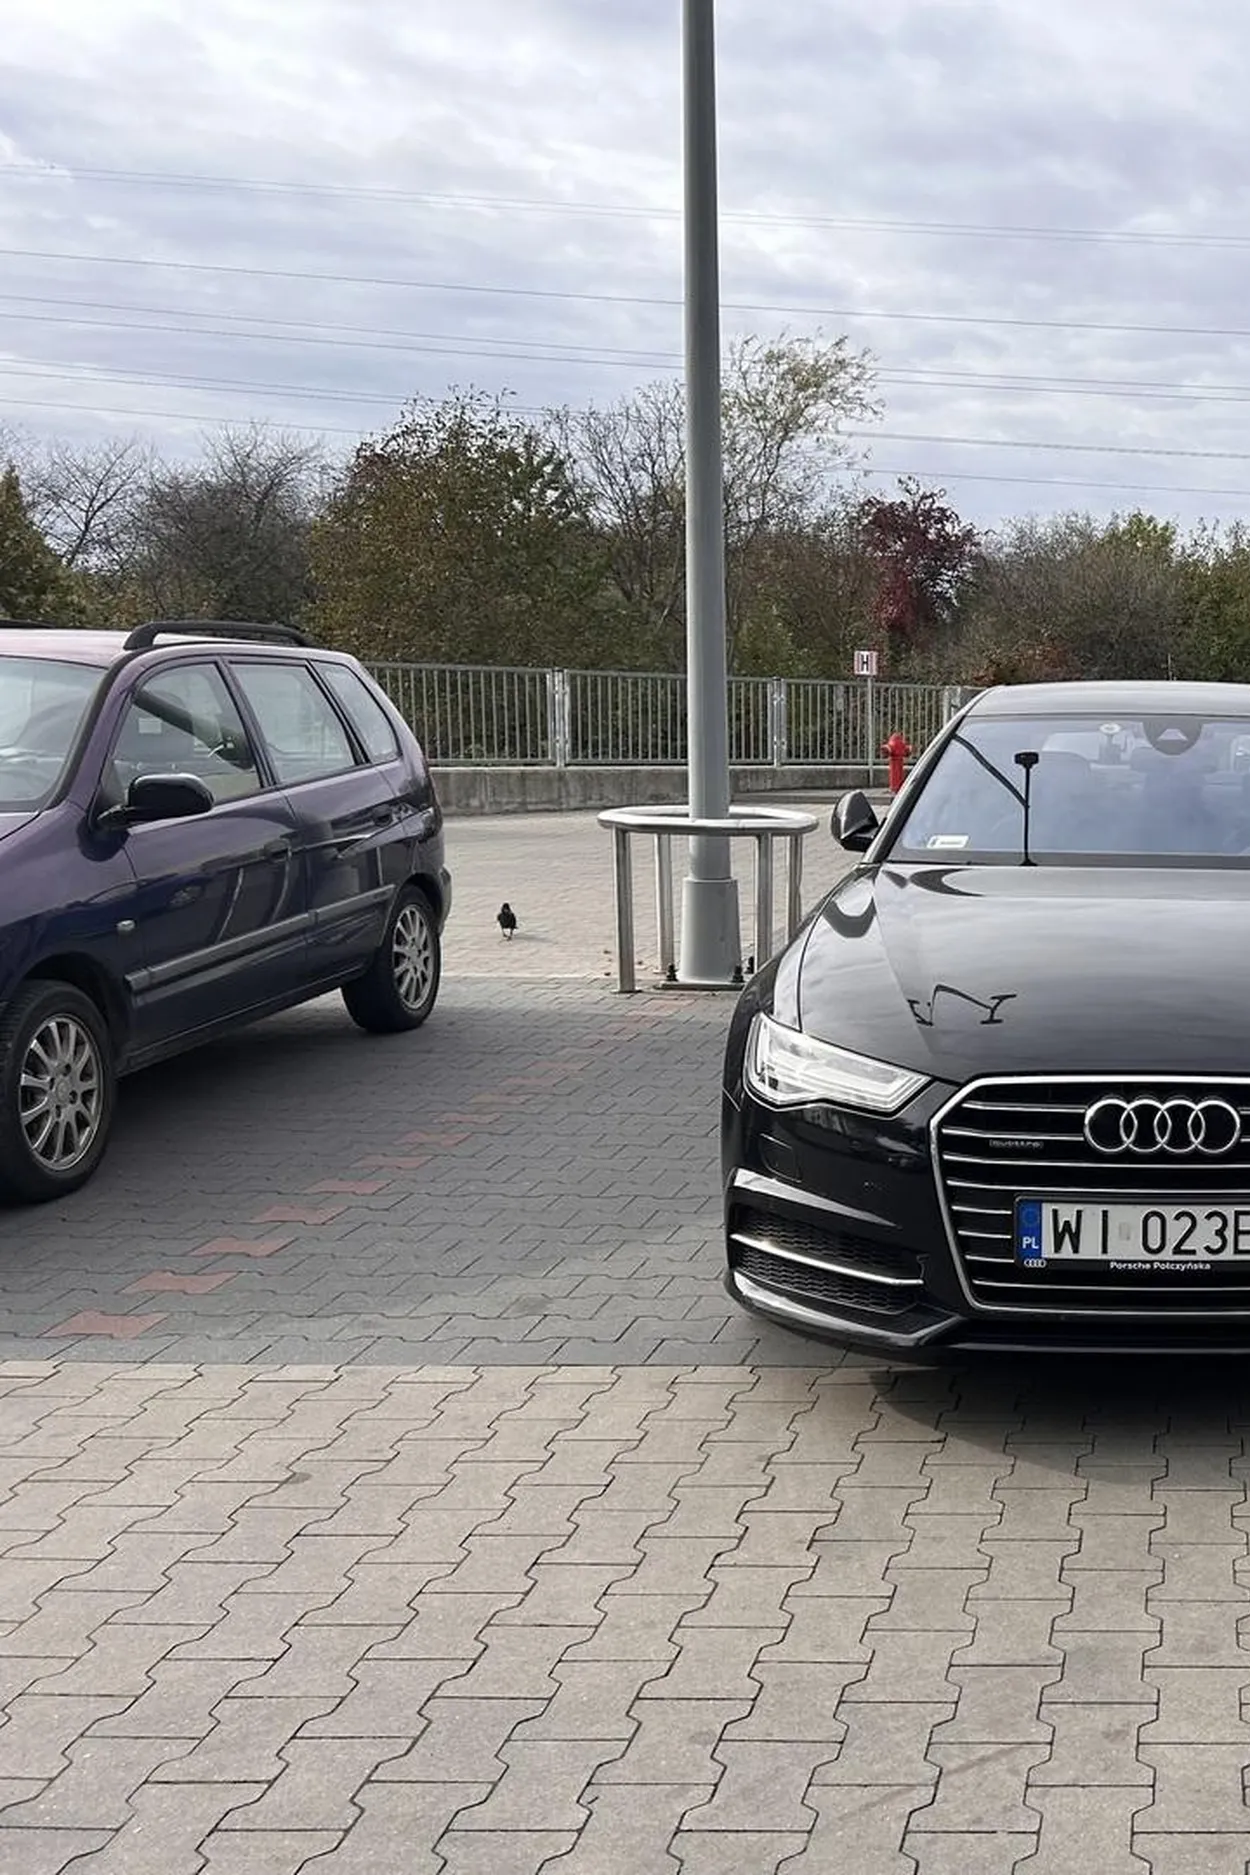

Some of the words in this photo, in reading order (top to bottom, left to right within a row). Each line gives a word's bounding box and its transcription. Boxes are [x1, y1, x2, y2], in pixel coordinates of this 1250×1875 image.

[860, 654, 869, 671] H
[1052, 1208, 1109, 1254] WI
[1022, 1237, 1039, 1250] PL
[1110, 1261, 1150, 1270] Porsche
[1153, 1261, 1211, 1272] Polczyńska
